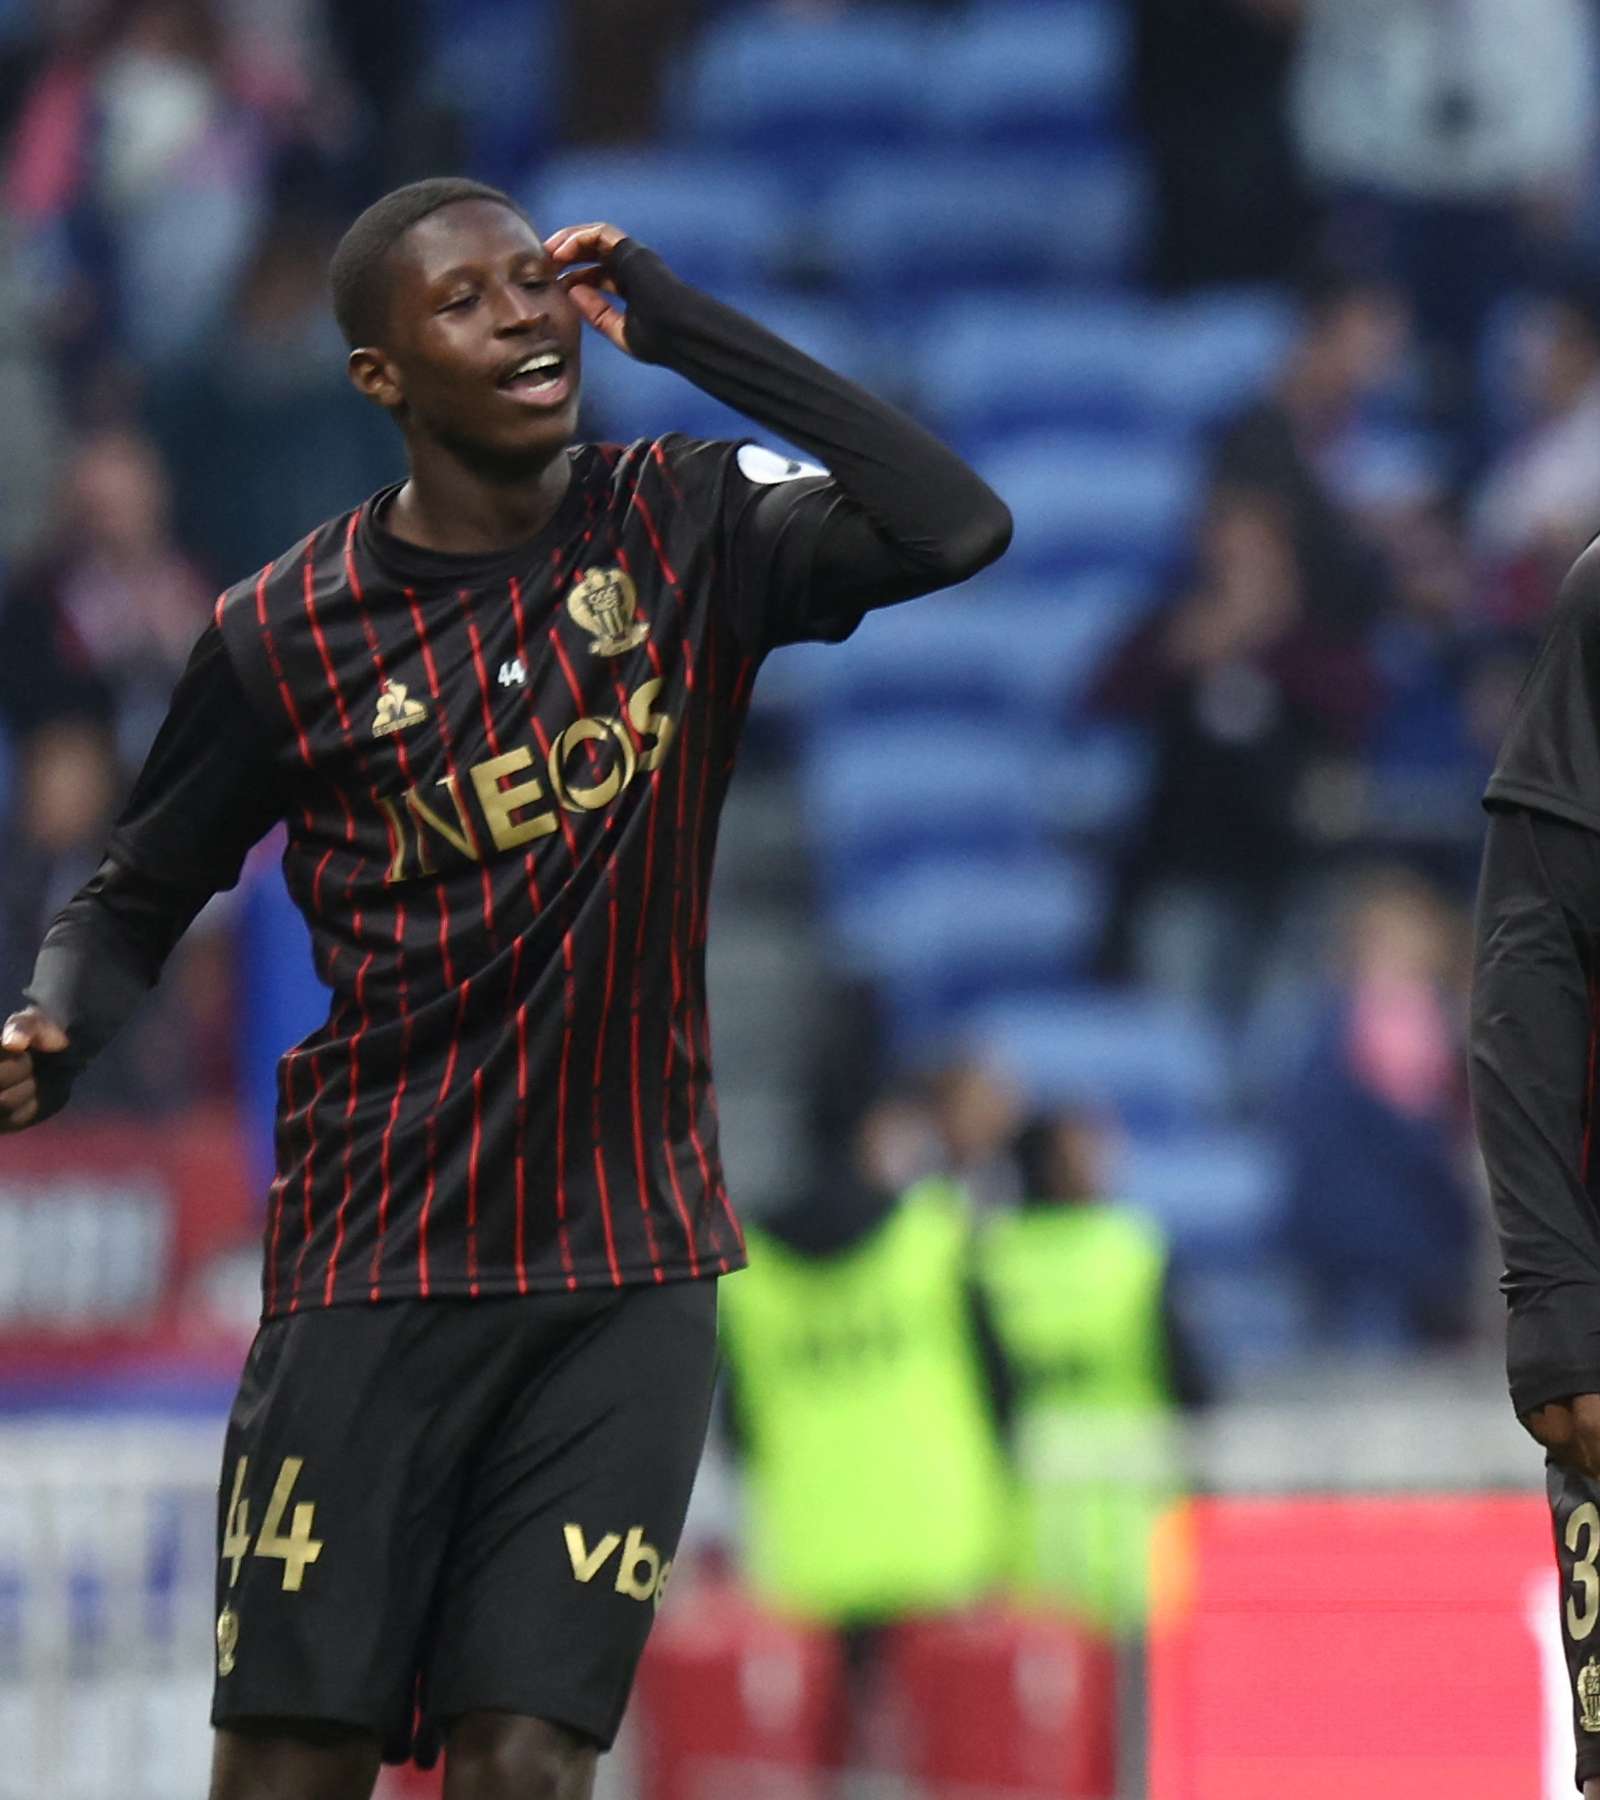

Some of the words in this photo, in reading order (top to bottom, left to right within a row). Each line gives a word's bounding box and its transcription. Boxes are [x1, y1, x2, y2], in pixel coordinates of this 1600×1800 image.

[497, 658, 526, 688] 44
[371, 676, 676, 883] INEOS
[221, 1456, 324, 1592] 44
